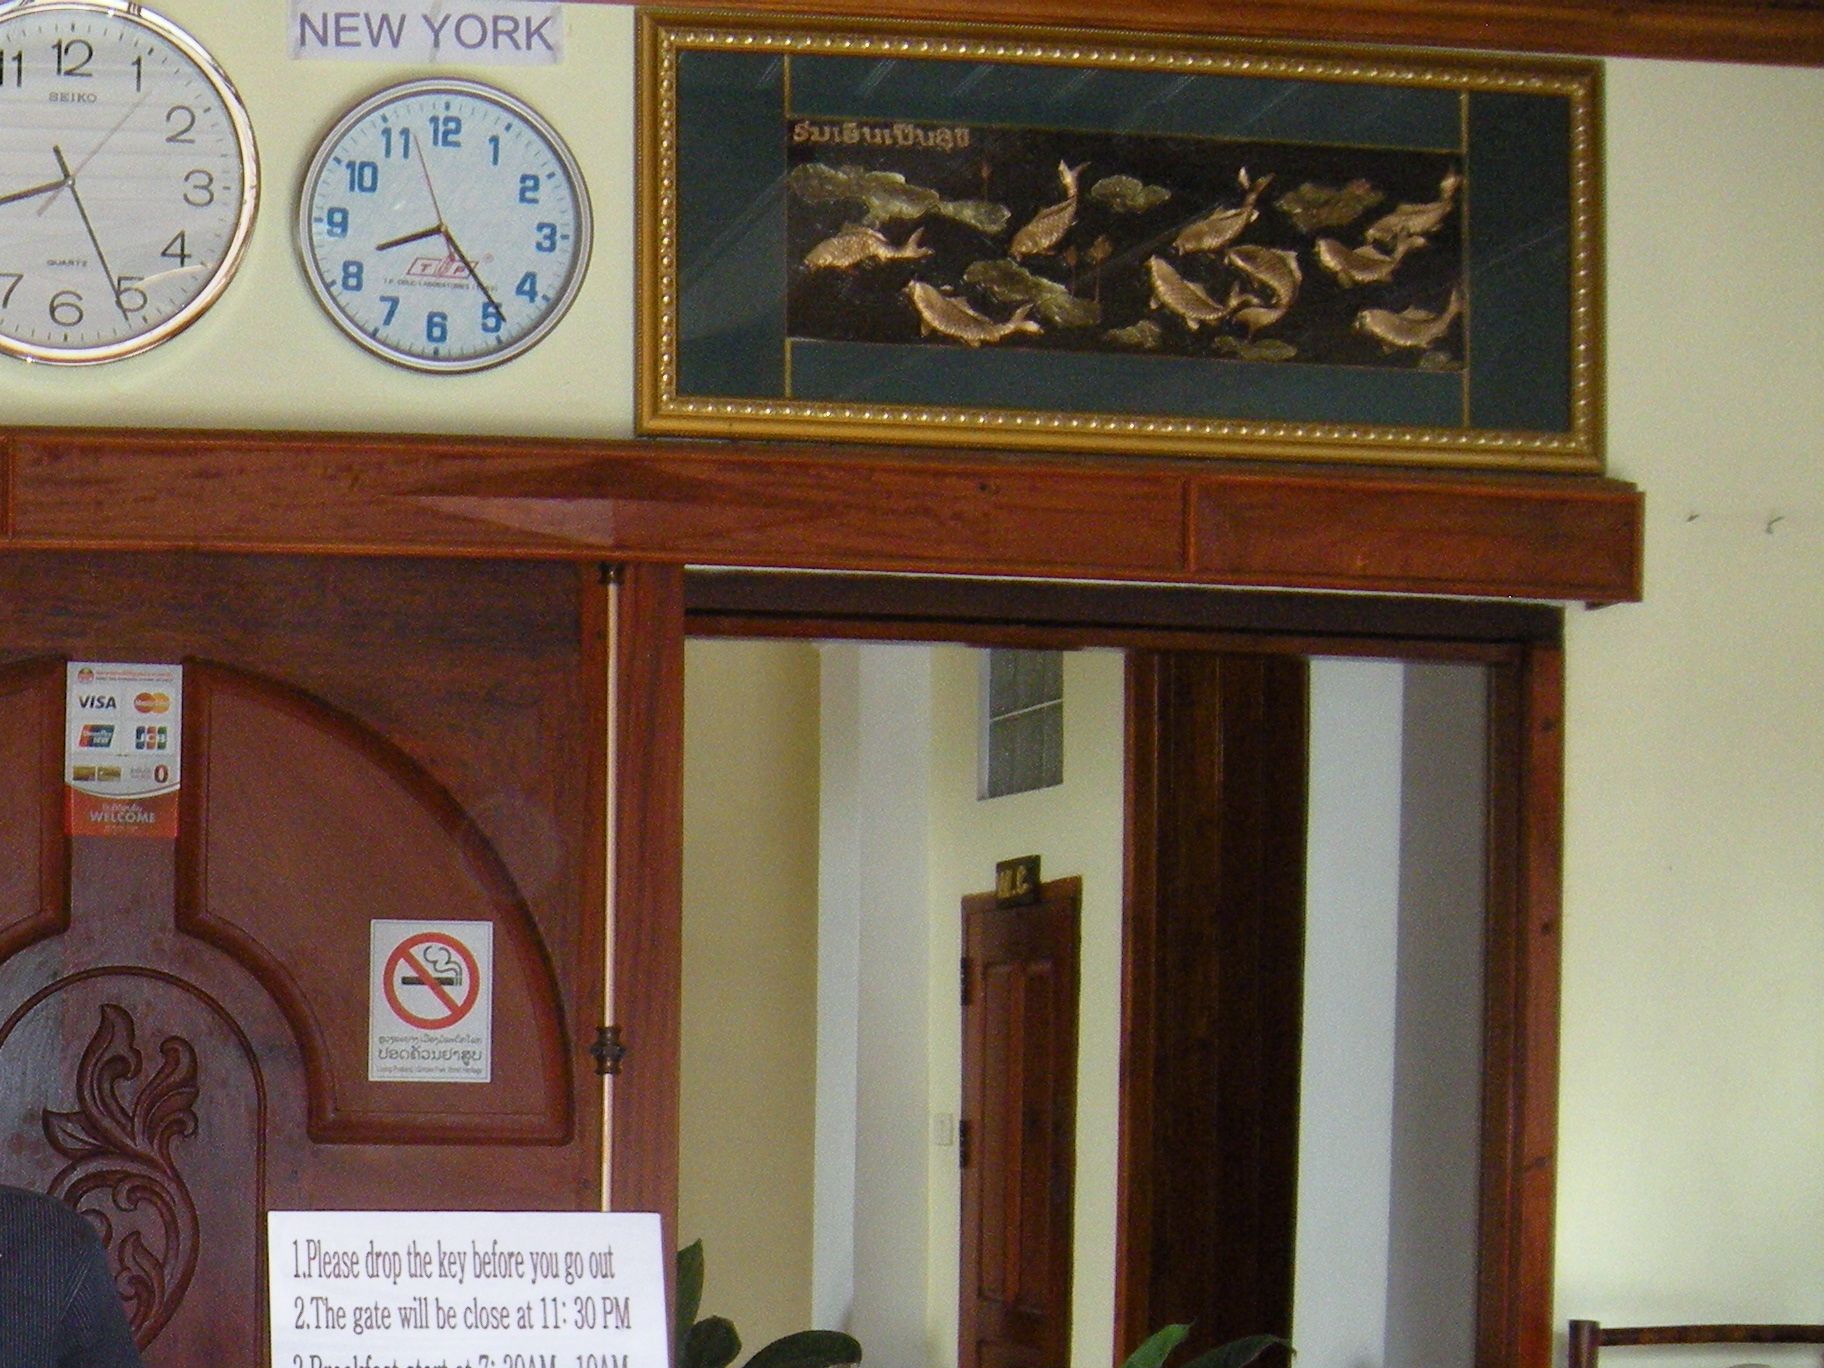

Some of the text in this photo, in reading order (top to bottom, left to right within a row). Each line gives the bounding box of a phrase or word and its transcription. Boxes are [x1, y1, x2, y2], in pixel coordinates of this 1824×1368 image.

[299, 12, 553, 50] NEW YORK
[52, 39, 93, 77] 12
[132, 56, 141, 92] 1
[48, 91, 97, 103] SEIKO
[165, 106, 195, 144] 2
[429, 116, 461, 148] 12
[381, 127, 411, 159] 11
[489, 135, 500, 166] 1
[183, 170, 214, 207] 3
[346, 161, 378, 193] 10
[518, 174, 539, 204] 2
[327, 207, 349, 238] 9
[536, 222, 557, 252] 3
[46, 259, 88, 267] QUARTZ
[160, 230, 191, 266] 4
[342, 261, 364, 291] 8
[515, 271, 538, 303] 4
[50, 291, 83, 326] 6
[115, 277, 147, 313] 5
[379, 295, 400, 326] 7
[426, 312, 447, 343] 6
[482, 302, 503, 333] 5
[78, 695, 117, 709] VISA
[90, 811, 156, 824] WELCOME
[293, 1240, 615, 1285] 1.Please drop the key before you go out
[295, 1297, 346, 1330] 2.The
[353, 1302, 391, 1335] gate
[399, 1297, 429, 1330] will
[436, 1297, 456, 1330] be
[464, 1297, 509, 1330] close
[517, 1303, 532, 1330] at
[602, 1297, 631, 1330] PM
